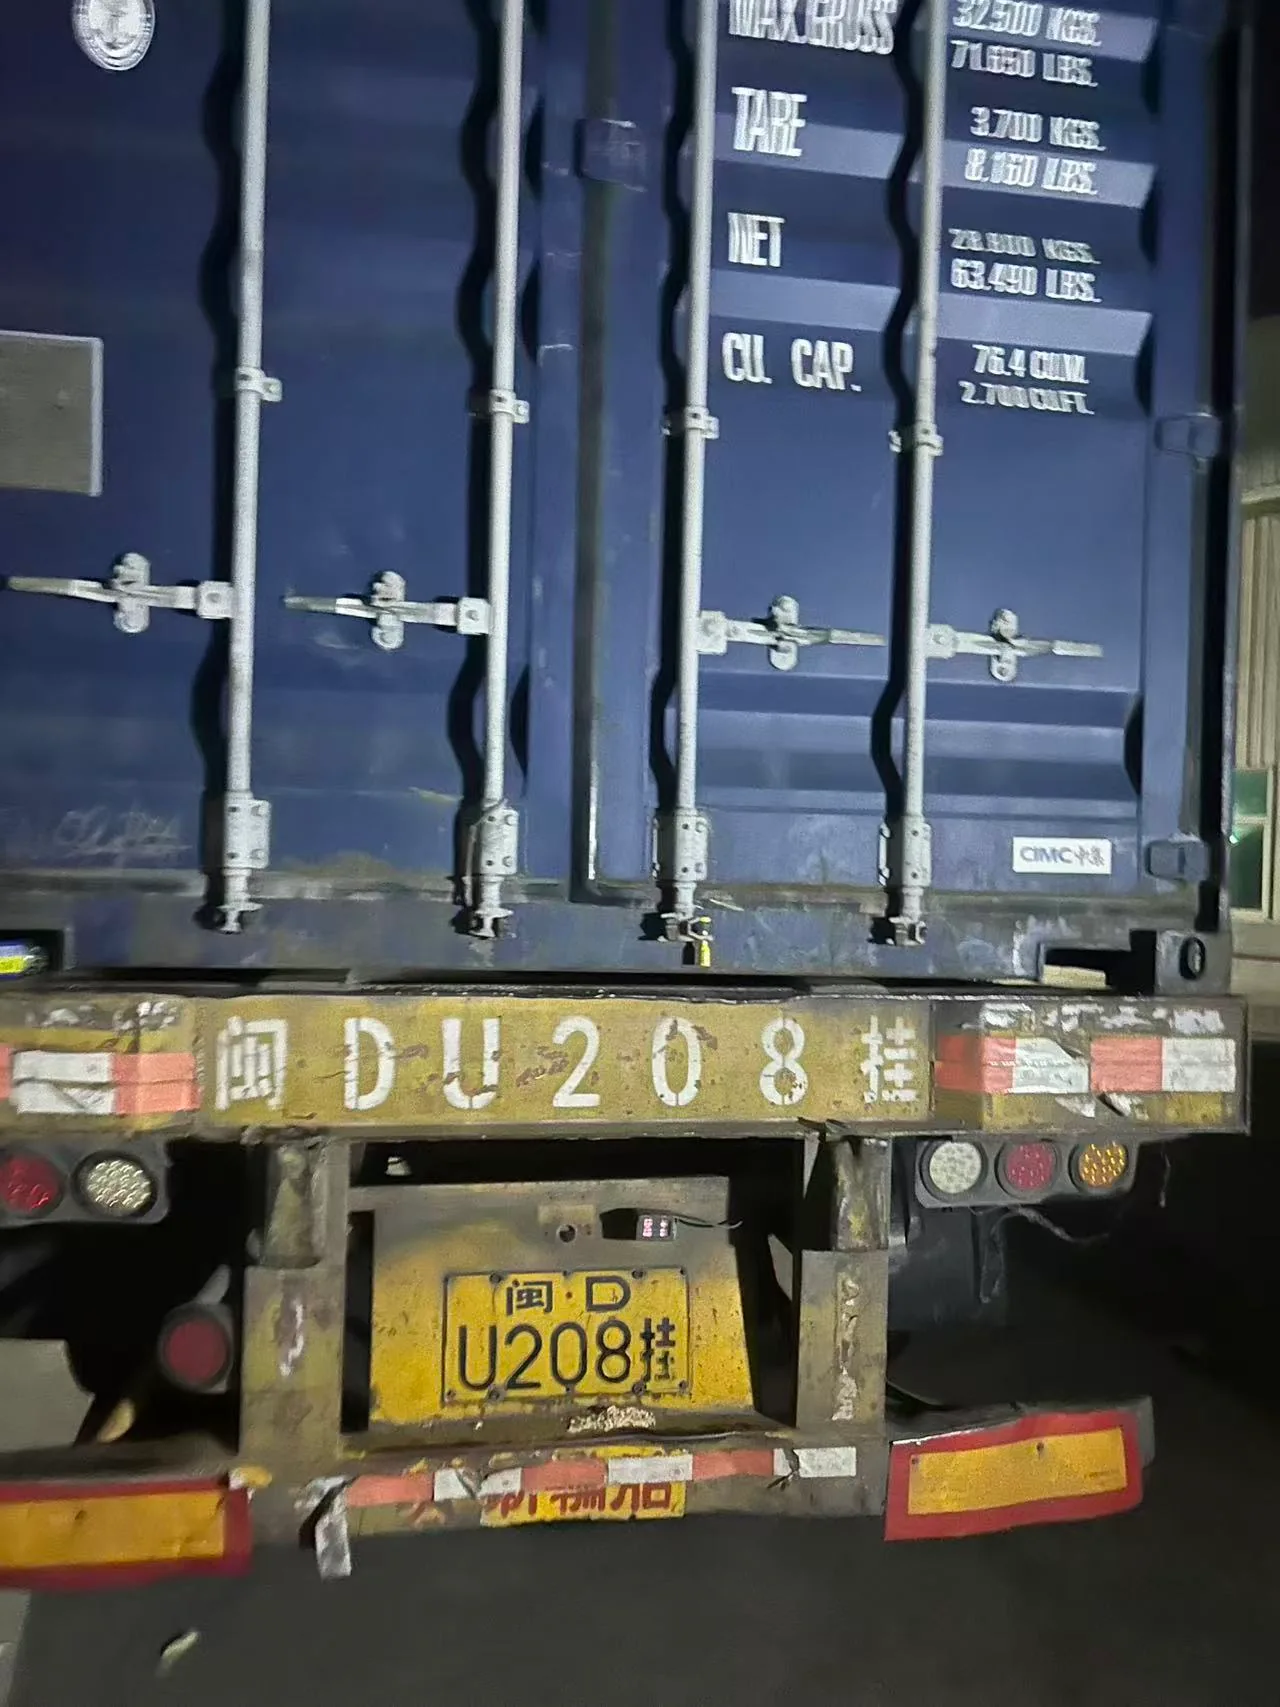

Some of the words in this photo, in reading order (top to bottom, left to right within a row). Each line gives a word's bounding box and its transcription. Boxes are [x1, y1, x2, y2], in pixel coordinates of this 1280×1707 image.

[732, 87, 807, 156] TARE
[728, 212, 785, 267] NET
[791, 338, 862, 391] CAP.
[458, 1316, 677, 1391] U208挂
